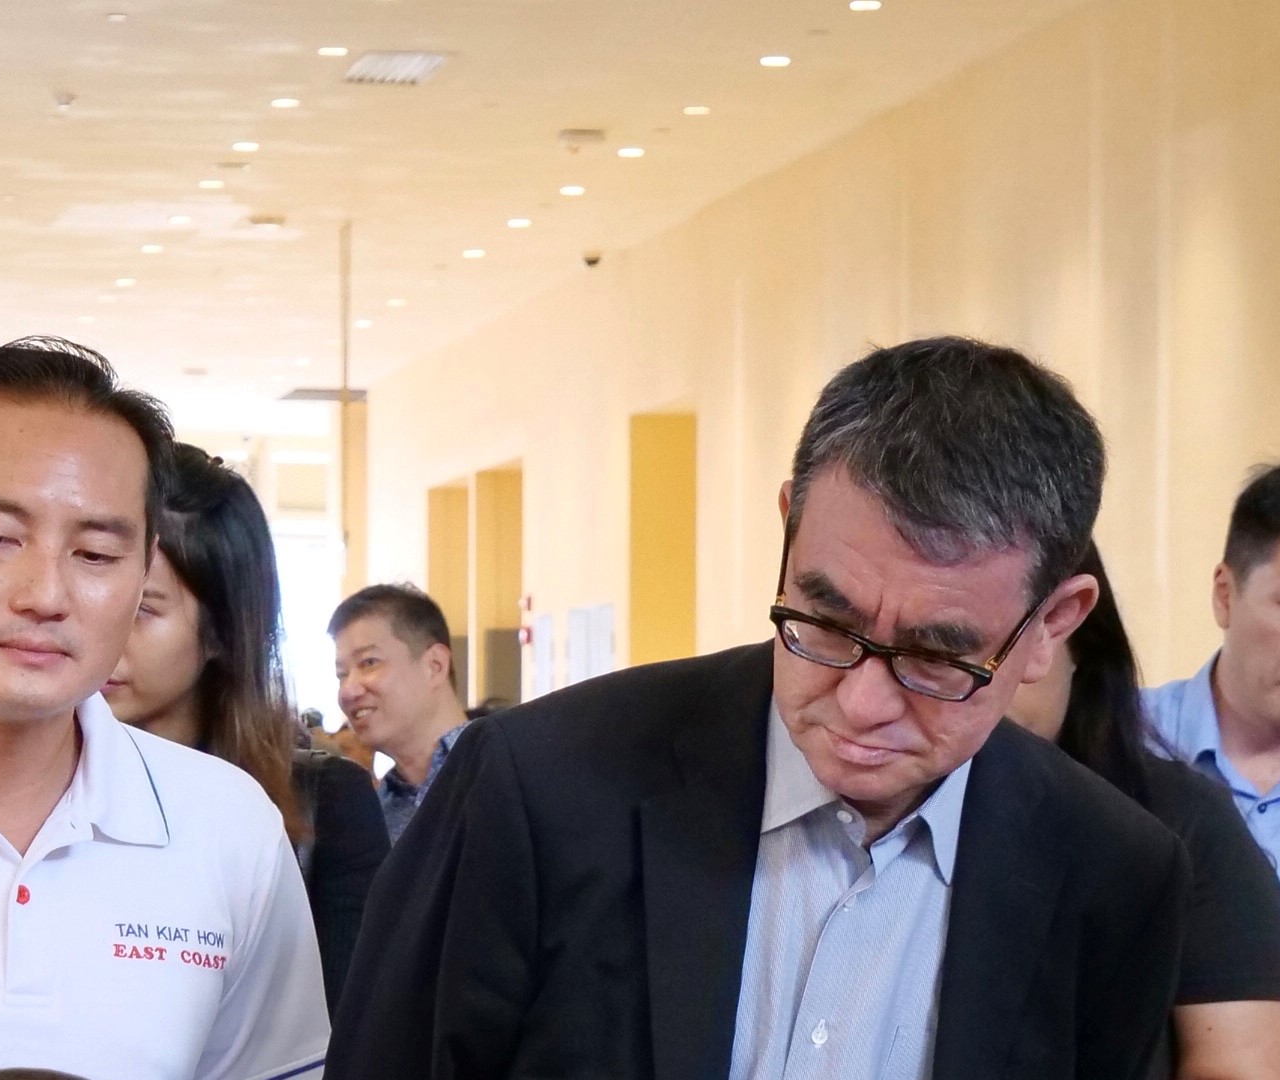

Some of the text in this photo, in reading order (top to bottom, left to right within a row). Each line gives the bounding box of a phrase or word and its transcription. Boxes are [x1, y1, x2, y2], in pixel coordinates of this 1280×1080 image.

[115, 923, 225, 949] TAN KIAT HOW
[113, 943, 227, 970] EAST COAST
